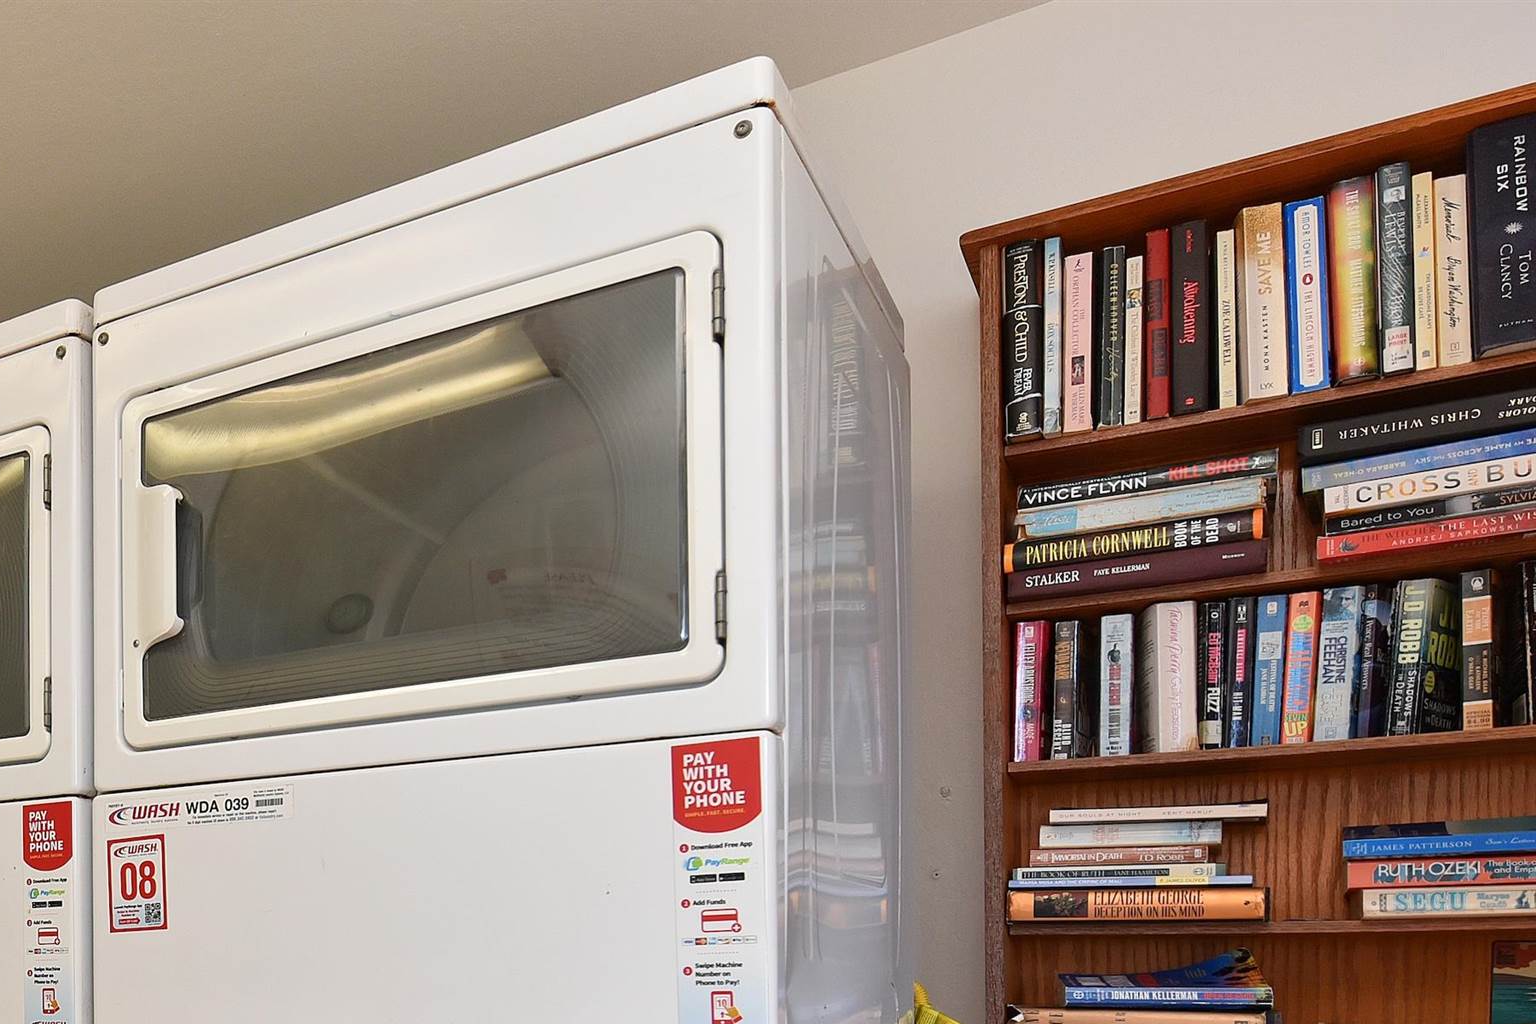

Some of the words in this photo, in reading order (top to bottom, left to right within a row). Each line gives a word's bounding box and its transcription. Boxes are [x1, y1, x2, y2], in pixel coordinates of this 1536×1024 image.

[1496, 164, 1509, 193] SIX
[1512, 134, 1528, 212] RAINBOW
[1345, 190, 1359, 204] THE
[1442, 197, 1461, 244] Memorial
[1255, 231, 1271, 254] ME
[1384, 213, 1397, 252] LEWIS
[1257, 259, 1273, 295] SAVE
[1441, 256, 1460, 282] Bryan
[1499, 243, 1513, 300] CLANCY
[1518, 250, 1532, 285] TOM
[1012, 254, 1030, 307] PRESTON
[1110, 264, 1119, 310] COLLEEN
[1071, 284, 1080, 317] ORPHAN
[1304, 290, 1313, 304] THE
[1443, 284, 1464, 329] Washington
[1014, 310, 1028, 321] &
[1178, 280, 1200, 344] Awakening
[1014, 321, 1030, 363] CHILD
[1071, 317, 1080, 364] COLLECTOR
[1222, 318, 1232, 366] CALDWELL
[1013, 368, 1024, 397] DREAM
[1022, 368, 1033, 391] FEVER
[1071, 400, 1079, 430] WISEMAN
[1430, 407, 1482, 426] CHRIS
[1338, 417, 1424, 440] WHITAKER
[1447, 447, 1482, 460] ACROSS
[1484, 442, 1512, 453] NAME
[1167, 464, 1201, 482] KILL
[1204, 456, 1251, 477] SHOT
[1364, 460, 1407, 473] BARBARA
[1413, 455, 1433, 466] SKY
[1023, 486, 1084, 506] VINCE
[1086, 476, 1148, 497] FLYNN
[1354, 470, 1462, 504] CROSS
[1190, 518, 1202, 532] THE
[1340, 513, 1383, 528] Bared
[1386, 511, 1402, 521] to
[1406, 506, 1435, 518] You
[1438, 521, 1466, 532] THE
[1472, 516, 1506, 528] LAST
[1173, 520, 1188, 549] BOOK
[1190, 532, 1201, 546] OF
[1205, 517, 1220, 543] DEAD
[1391, 534, 1444, 547] ANDRZEJ
[1449, 523, 1521, 539] SAPKOWSKI
[1024, 541, 1089, 566] PATRICIA
[1091, 526, 1172, 556] CORNWELL
[1024, 570, 1080, 588] STALKER
[1093, 568, 1110, 577] FAYE
[1111, 562, 1150, 575] KELLERMAN
[1208, 632, 1221, 646] Ed
[1397, 618, 1423, 665] ROBB
[1023, 642, 1038, 666] KELLEY
[1207, 646, 1221, 684] McBain
[1321, 636, 1337, 685] FEEHAN
[1335, 635, 1348, 684] CHRISTINE
[1206, 686, 1221, 714] FUZZ
[1392, 681, 1406, 713] DEATH
[1403, 669, 1418, 717] SHADOWS
[1053, 719, 1063, 751] DESCENT
[1061, 723, 1072, 746] BLIND
[682, 752, 715, 767] PAY
[682, 764, 729, 781] WITH
[682, 778, 732, 795] YOUR
[131, 802, 181, 820] WASH
[185, 800, 220, 815] WDA
[224, 797, 249, 812] 039
[684, 790, 746, 809] PHONE
[28, 810, 48, 822] PAY
[28, 819, 55, 832] WITH
[28, 830, 56, 842] YOUR
[29, 839, 64, 853] PHONE
[690, 842, 724, 851] Download
[723, 841, 739, 849] Free
[739, 840, 753, 849] App
[1371, 843, 1406, 853] JAMES
[1408, 840, 1473, 850] PATTERSON
[127, 842, 158, 855] WASH
[1095, 851, 1124, 862] DEATH
[1039, 870, 1065, 878] BOOK
[1067, 869, 1080, 878] OF
[1377, 862, 1427, 877] RUTH
[1428, 860, 1482, 876] OZEKI
[119, 860, 157, 901] 08
[706, 898, 726, 906] Funds
[1093, 889, 1156, 906] ELIZABETH
[1158, 889, 1204, 906] GEORGE
[1394, 891, 1469, 912] SEGU
[1093, 905, 1143, 919] DECEPTION
[1145, 904, 1160, 918] ON
[1160, 904, 1179, 917] HIS
[1178, 904, 1204, 917] MIND
[694, 962, 715, 970] Swipe
[695, 979, 716, 987] Phone
[1110, 990, 1150, 1001] JONATHAN
[1151, 991, 1199, 1001] KELLERMAN
